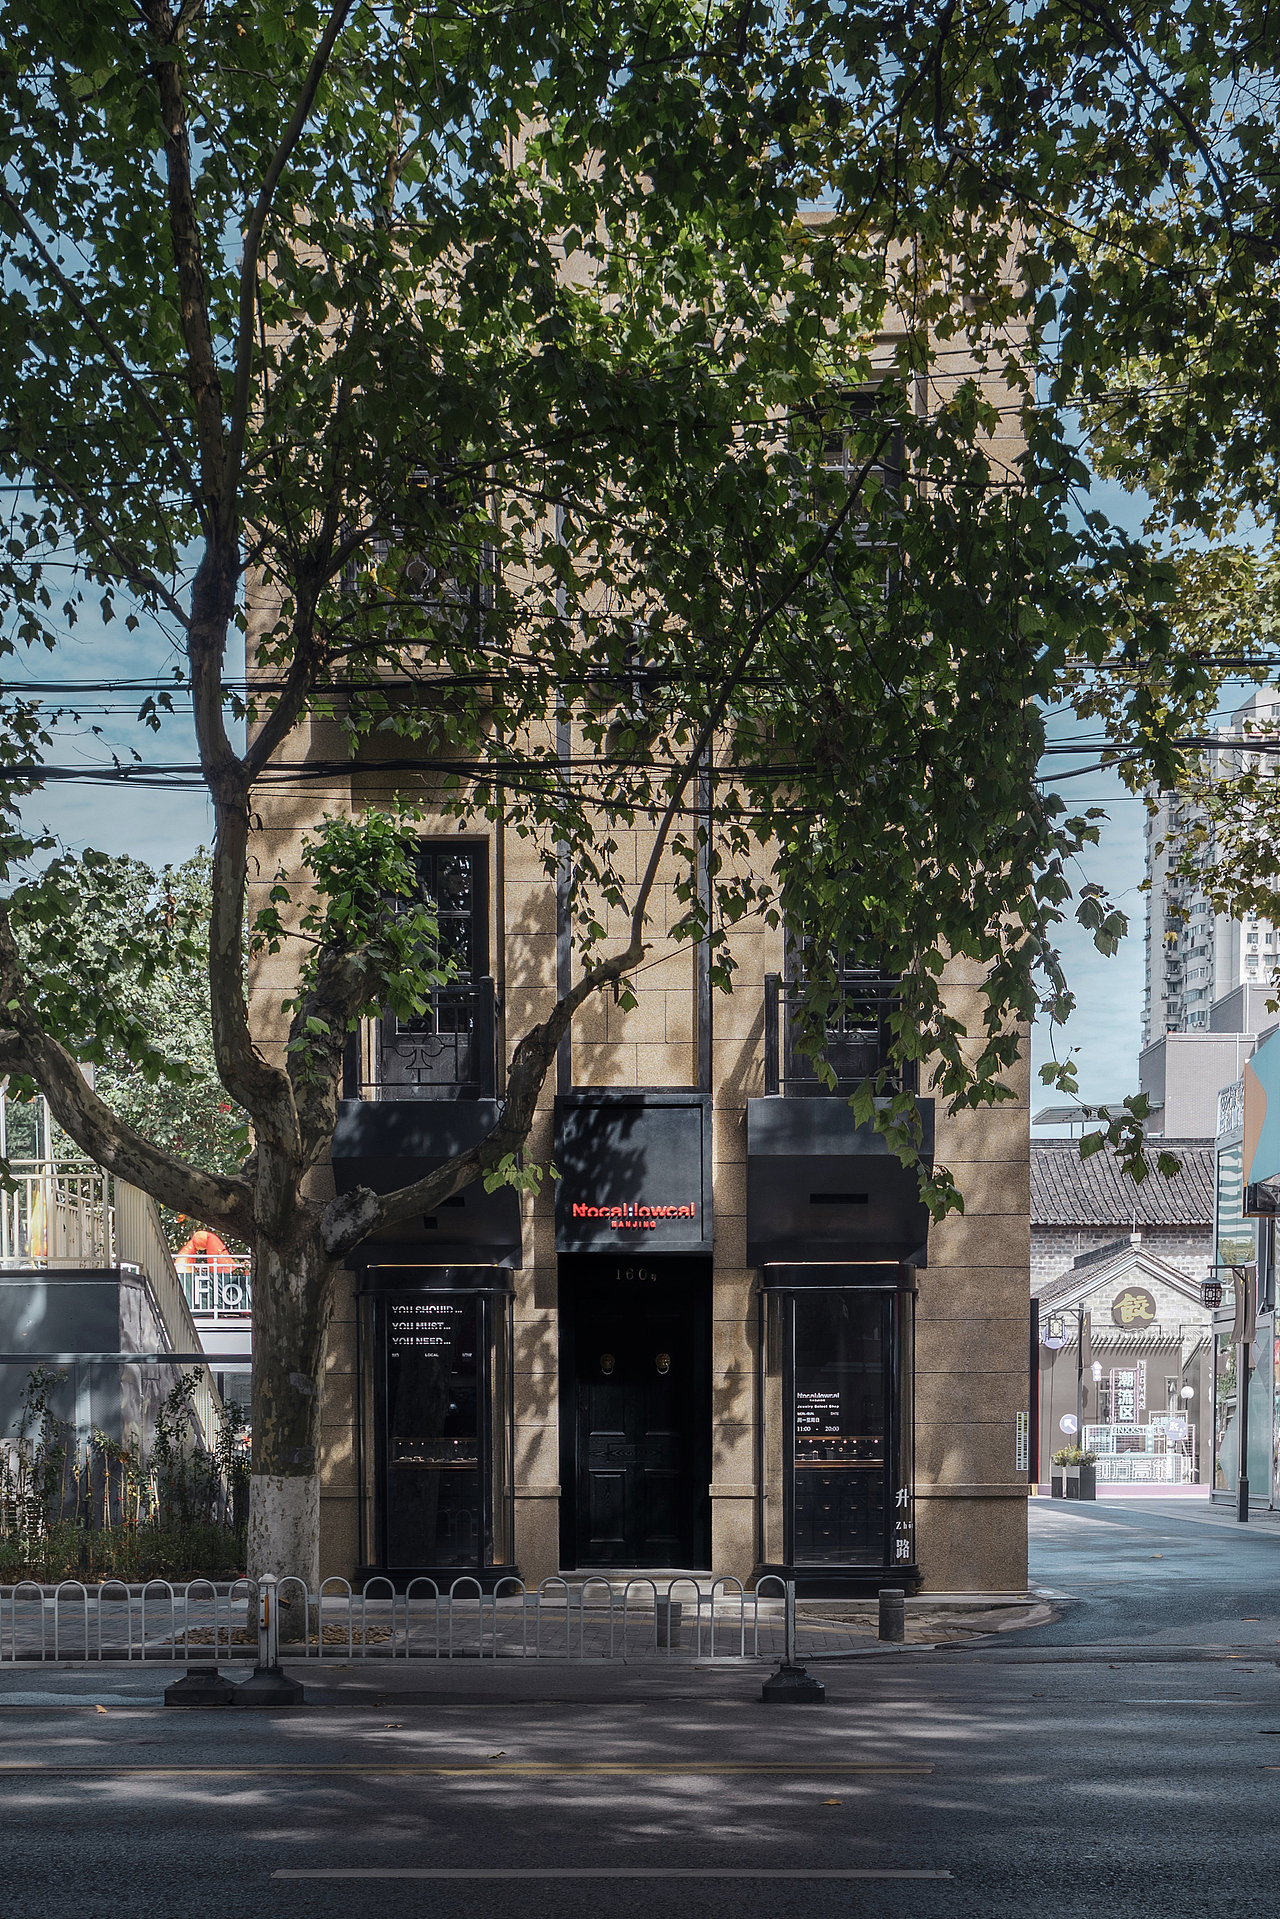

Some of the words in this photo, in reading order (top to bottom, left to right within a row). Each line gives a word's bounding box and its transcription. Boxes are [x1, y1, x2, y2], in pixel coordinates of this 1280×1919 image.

[611, 1220, 657, 1228] NANJING
[392, 1322, 414, 1330] YOU
[392, 1337, 414, 1345] YOU
[1117, 1371, 1134, 1420] 潮流区
[895, 1539, 910, 1559] 路
